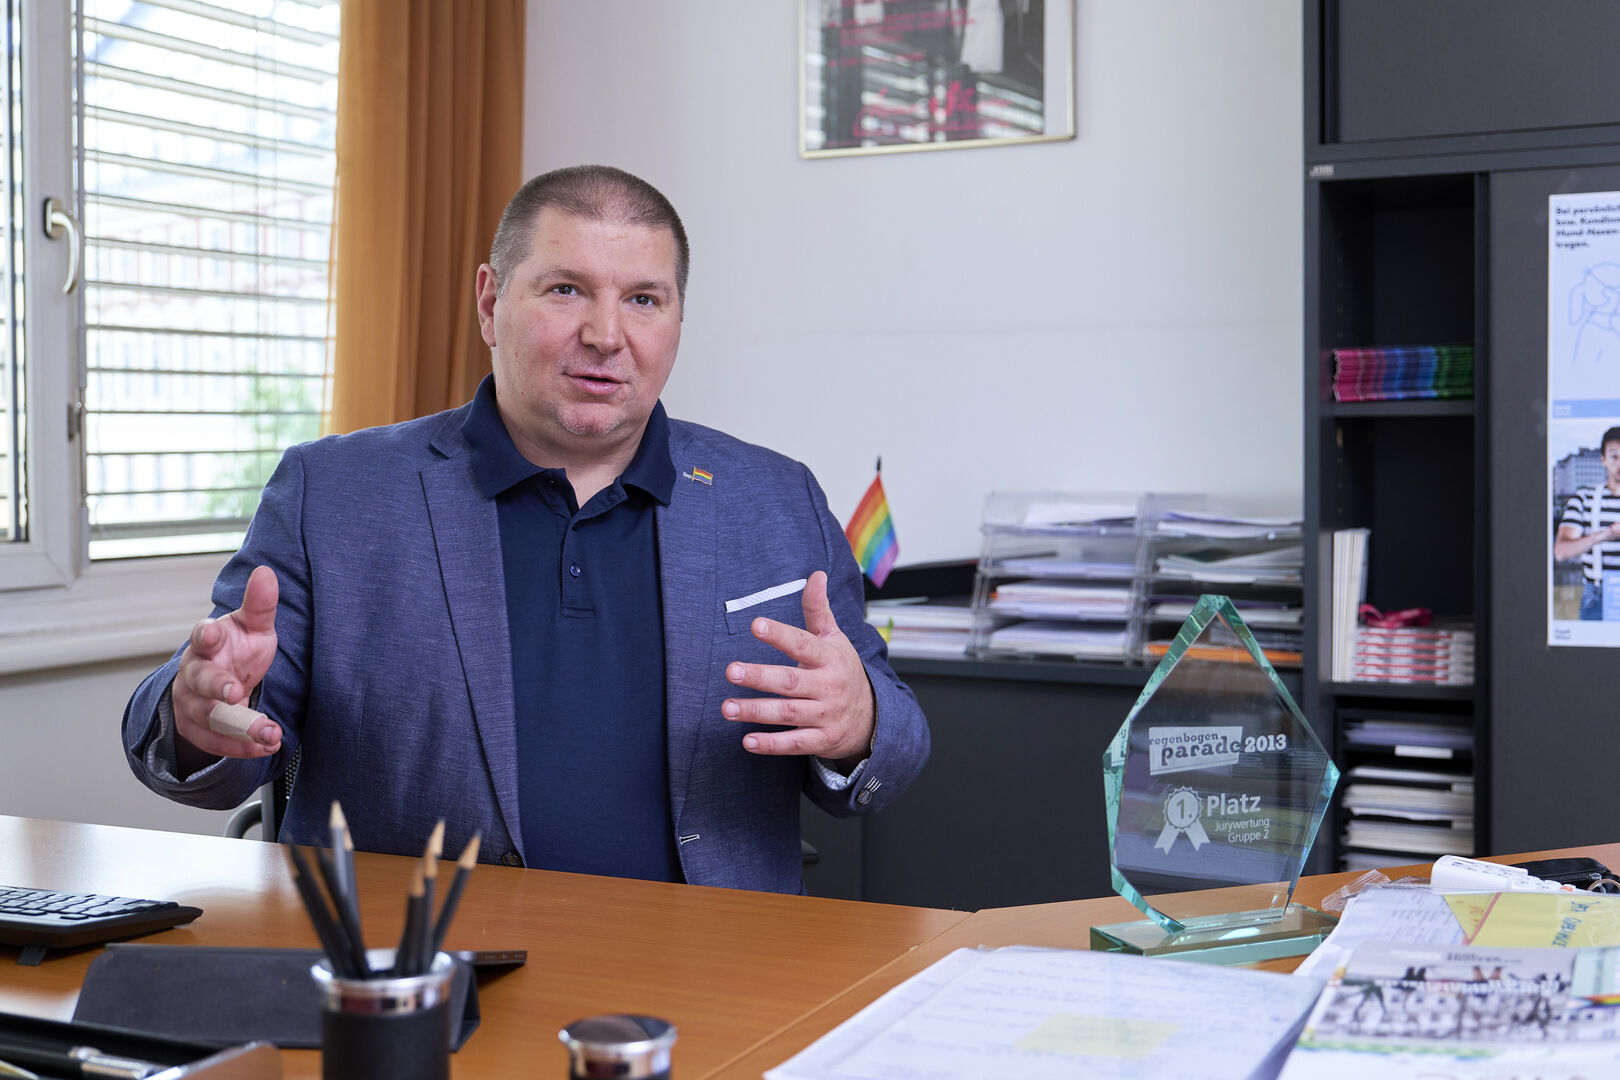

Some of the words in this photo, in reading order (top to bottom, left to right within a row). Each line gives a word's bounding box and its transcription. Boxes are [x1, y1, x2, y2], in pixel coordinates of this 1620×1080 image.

[1149, 732, 1219, 747] regenbogen
[1161, 735, 1241, 766] parade
[1244, 733, 1287, 753] 2013
[1176, 798, 1193, 820] 1.
[1206, 793, 1261, 817] Platz
[1215, 818, 1270, 833] Jurywertung
[1228, 831, 1261, 844] Gruppe
[1263, 828, 1270, 840] 2
